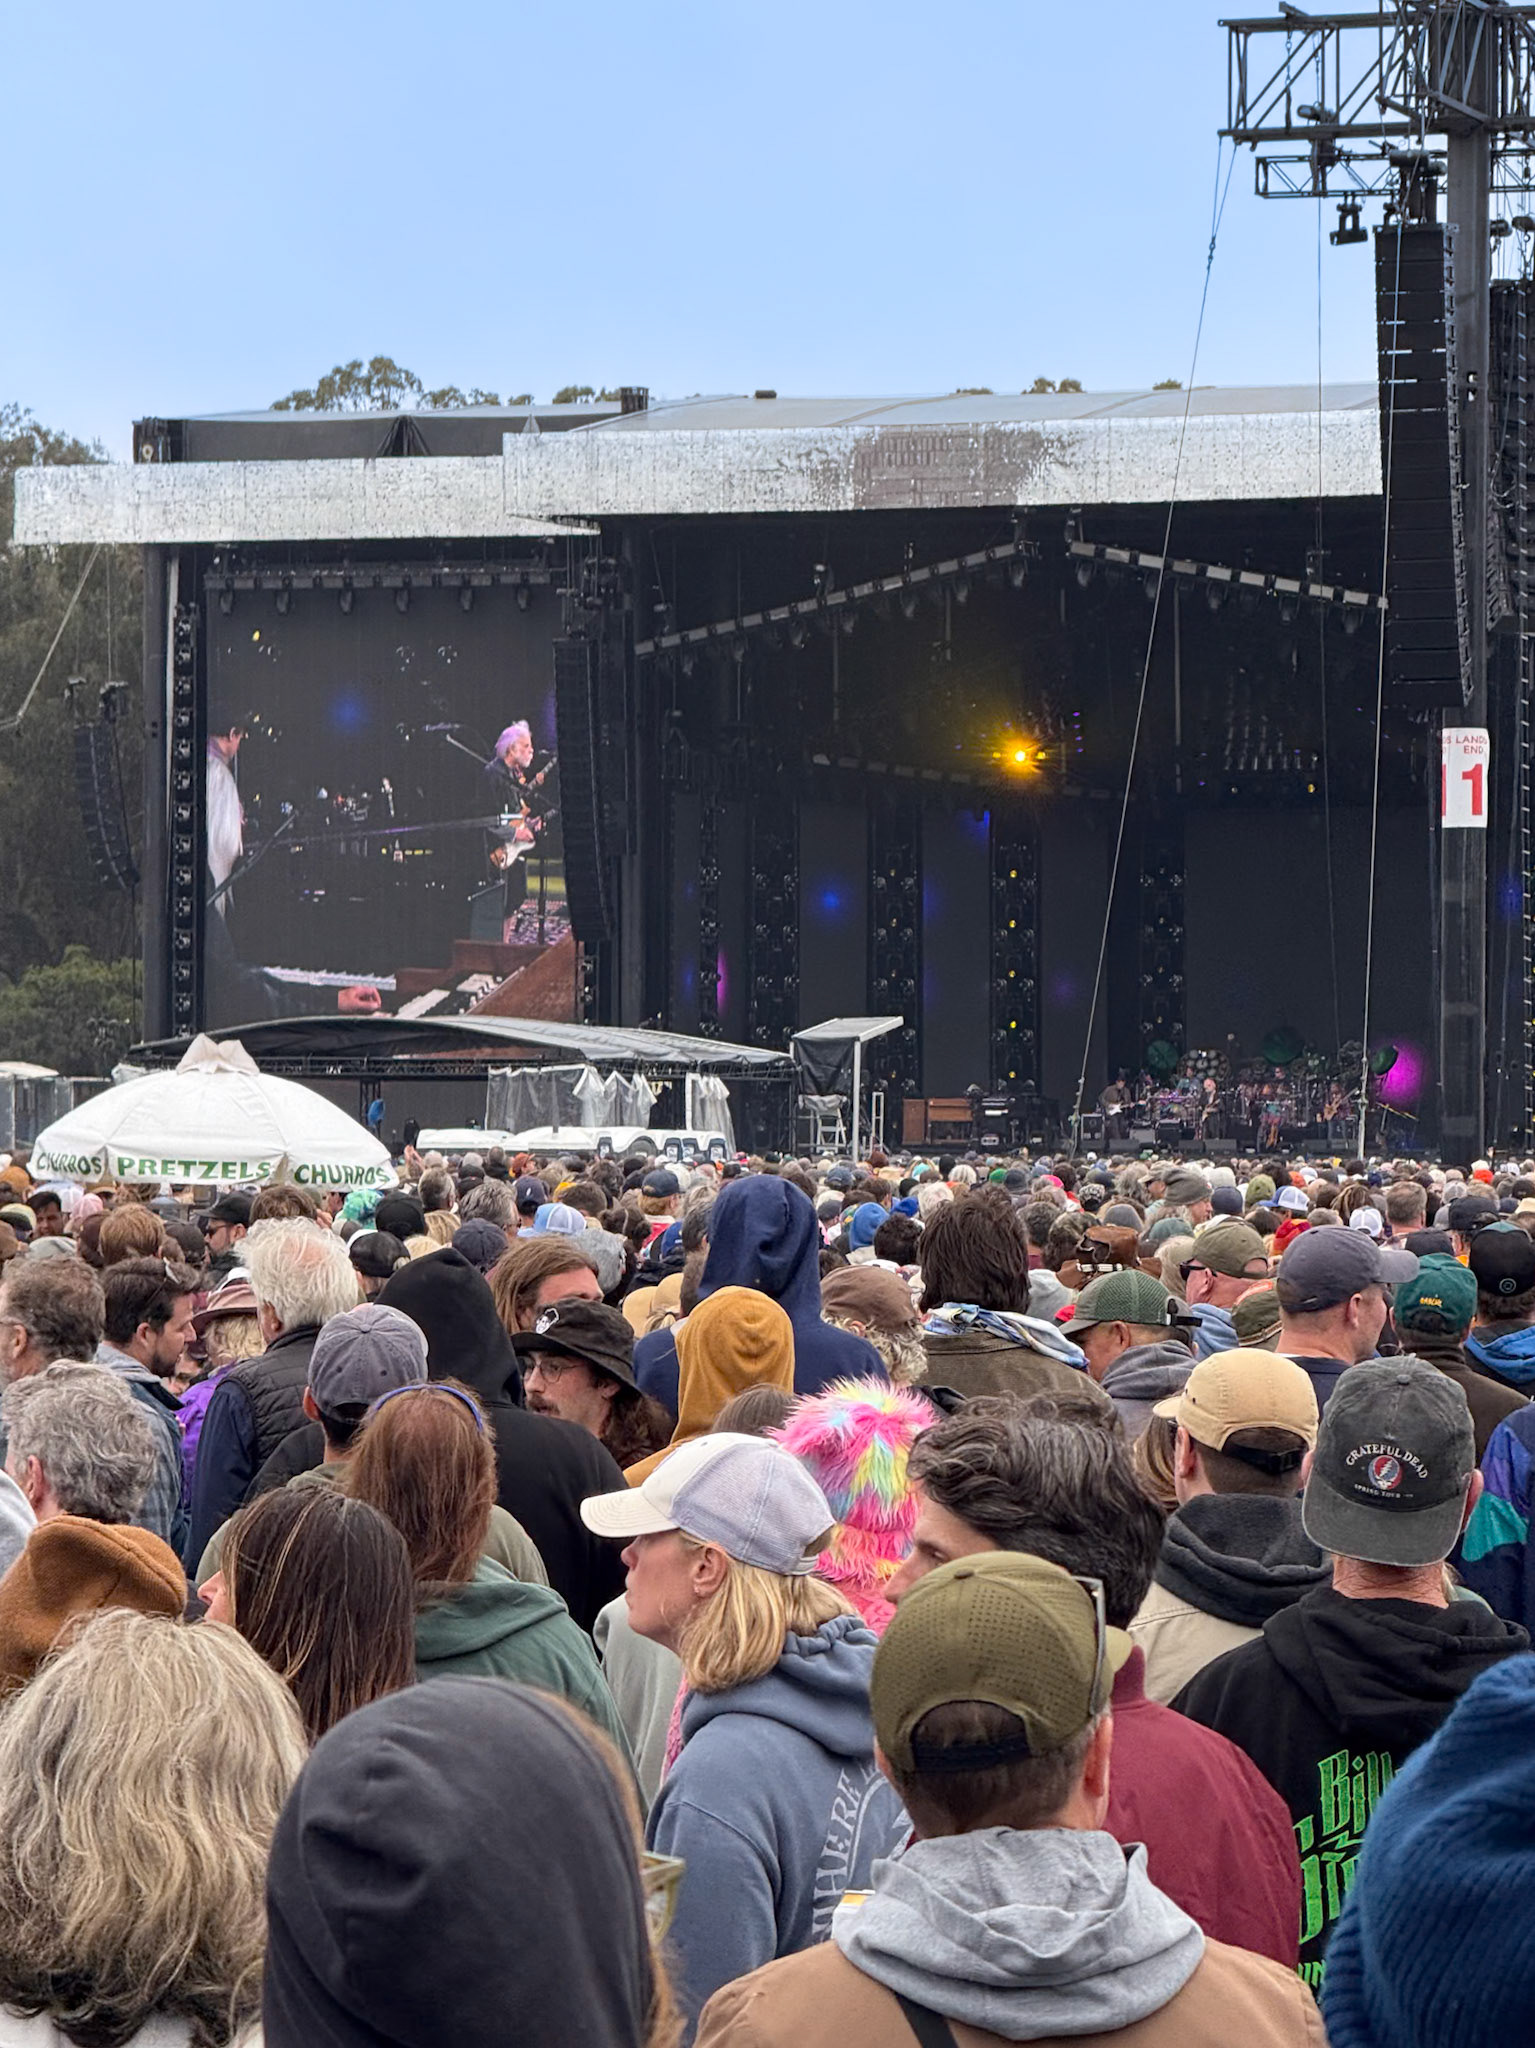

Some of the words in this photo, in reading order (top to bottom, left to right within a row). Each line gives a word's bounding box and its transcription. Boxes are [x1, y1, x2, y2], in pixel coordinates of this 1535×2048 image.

[1464, 745, 1484, 754] END
[1462, 763, 1483, 816] 1
[37, 1151, 102, 1176] CHURROS
[117, 1156, 272, 1181] PRETZELS
[293, 1163, 392, 1187] CHURROS
[1346, 1443, 1402, 1466] GRATEFUL
[1402, 1451, 1428, 1479] DEAD
[1318, 1749, 1403, 1837] Bill
